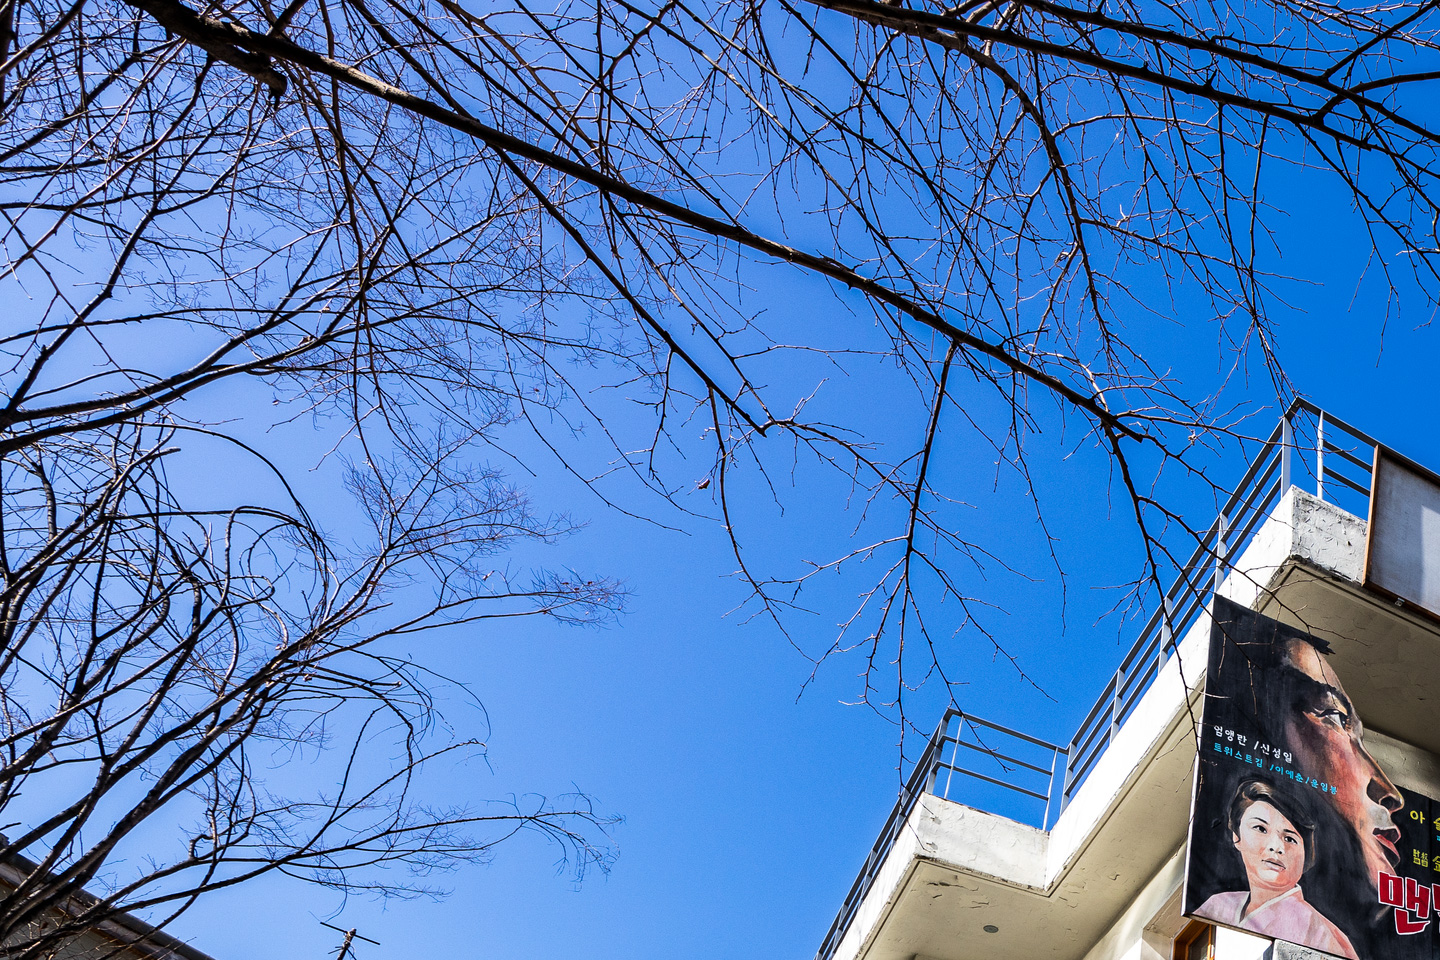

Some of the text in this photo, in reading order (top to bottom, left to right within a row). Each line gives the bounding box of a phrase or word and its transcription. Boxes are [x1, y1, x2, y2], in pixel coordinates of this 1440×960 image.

[1213, 725, 1247, 747] 엄앵란
[1213, 742, 1263, 768] 트위스트김
[1409, 810, 1425, 824] 아
